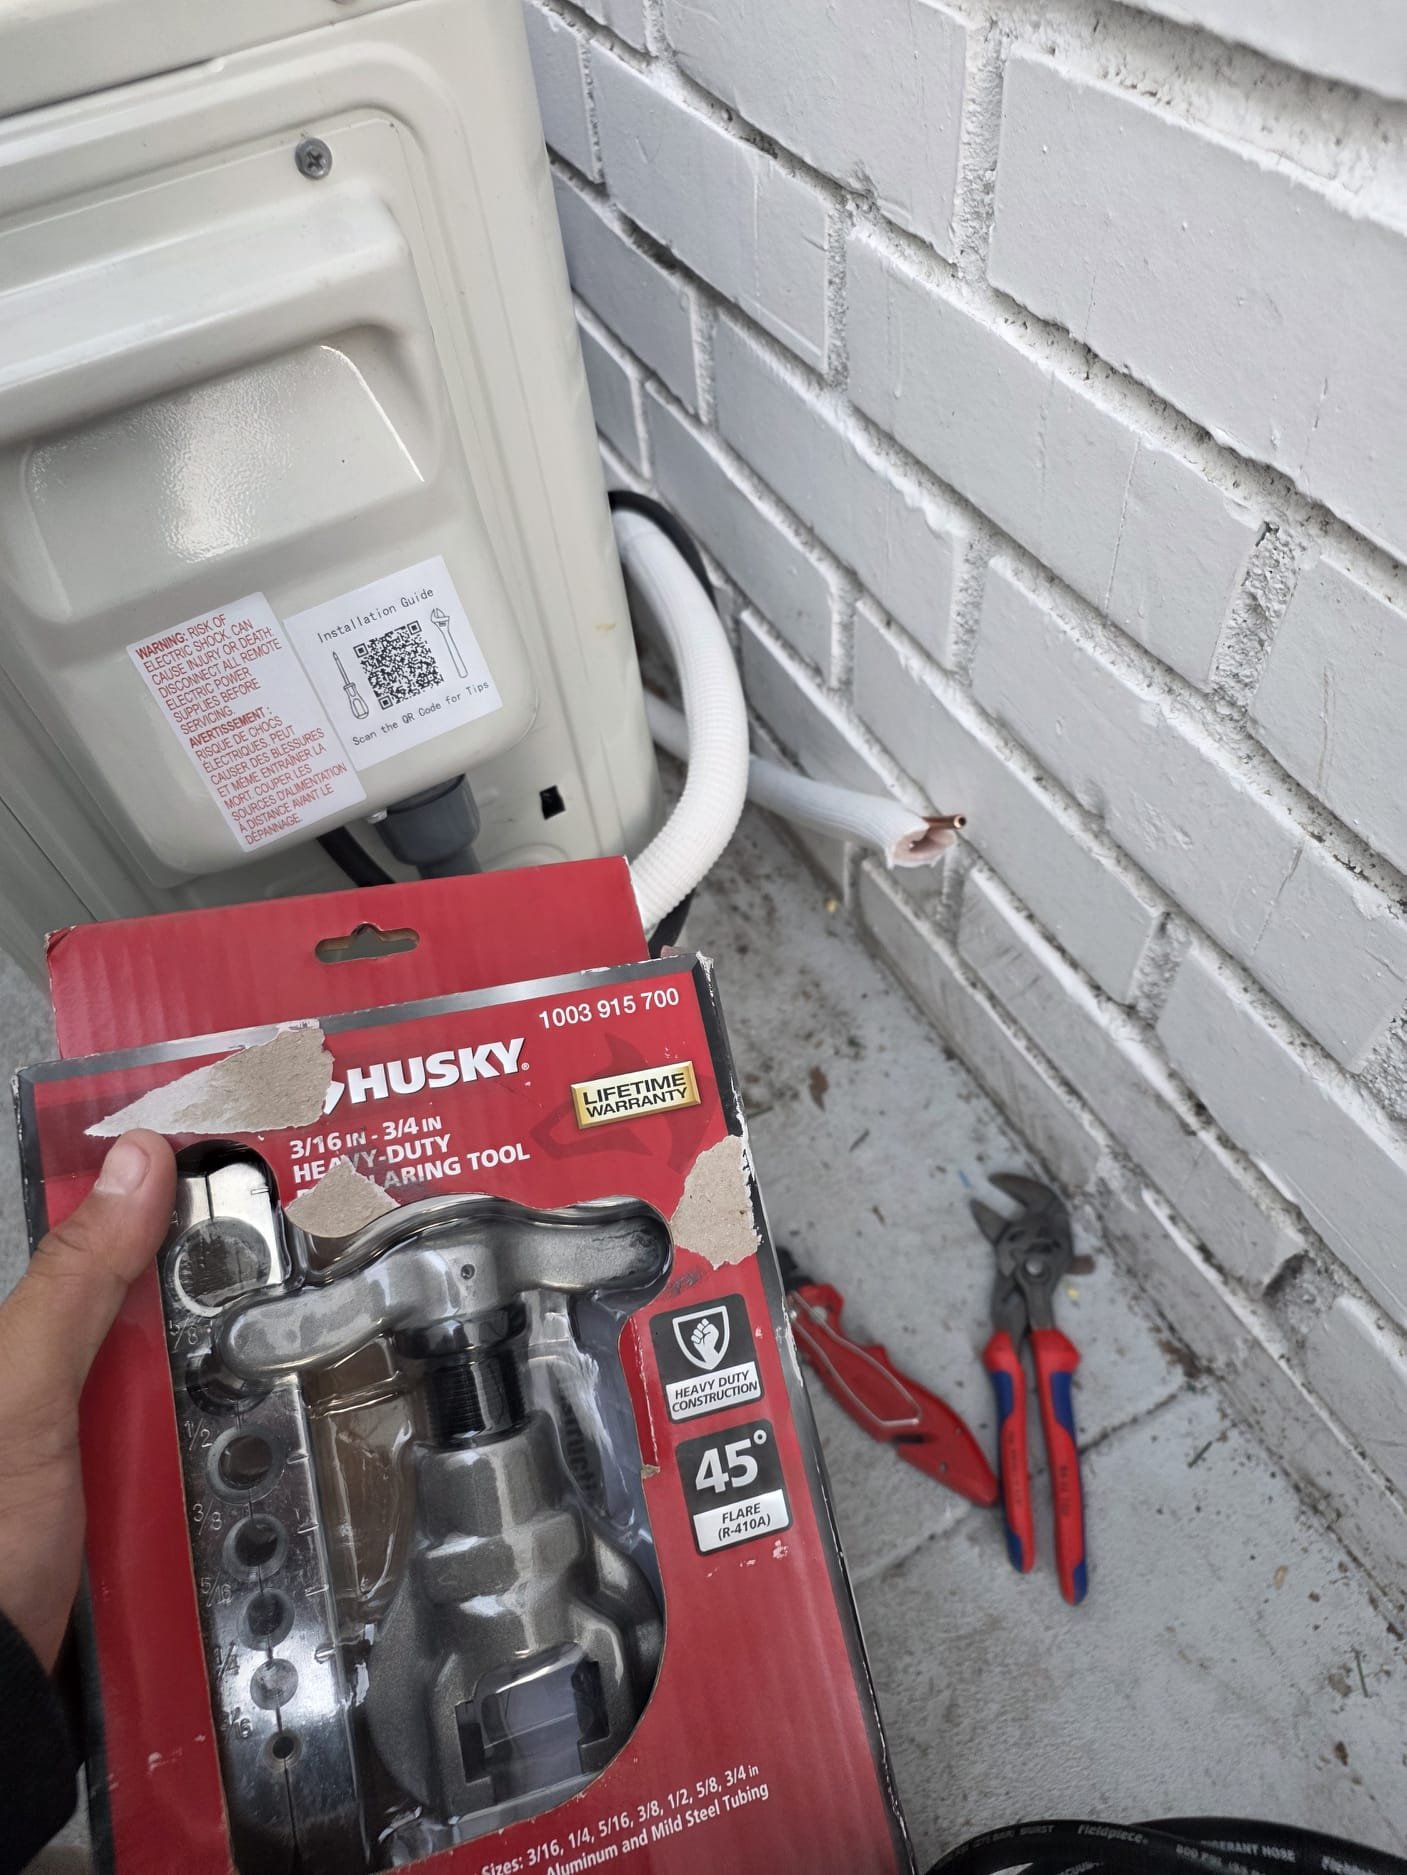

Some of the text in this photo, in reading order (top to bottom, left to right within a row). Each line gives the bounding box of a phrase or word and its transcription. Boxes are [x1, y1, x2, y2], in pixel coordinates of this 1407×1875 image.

[136, 614, 226, 659] WARNING: RISK OF
[318, 589, 433, 642] Installation Guide
[144, 645, 192, 672] ELECTRIC
[231, 619, 253, 636] CAN
[152, 663, 186, 685] CAUSE
[186, 648, 220, 670] INJURY
[222, 641, 239, 655] OR
[158, 639, 281, 698] DISCONNECT ALL REMOTE
[166, 667, 251, 710] ELECTRIC POWER
[173, 678, 260, 722] SUPPLIES BEFORE
[352, 682, 488, 746] Scan the QR Code for Tips
[190, 708, 264, 747] AVERTISSEMENT
[195, 716, 282, 760] RISQUE DE CHOCS
[269, 725, 294, 744] PEUT
[210, 728, 324, 784] CAUSER DES BLESSURES
[216, 784, 230, 798] ET
[260, 749, 312, 778] ENTRAÎNER
[312, 743, 326, 755] LA
[232, 764, 346, 821] SOURCES D'ALIMENTATION
[254, 772, 293, 796] COUPER
[293, 764, 312, 779] LES
[246, 803, 291, 829] DISTANCE
[292, 789, 319, 809] AVANT
[320, 783, 334, 796] LE
[539, 988, 680, 1030] 1003 915 700
[582, 1072, 686, 1106] LIFETIME
[586, 1086, 688, 1118] WARRANTY
[290, 1132, 342, 1160] 3/16
[346, 1131, 367, 1148] IN
[382, 1117, 420, 1140] 3/4
[422, 1116, 442, 1132] IN
[466, 1143, 530, 1170] TOOL
[672, 1380, 758, 1412] CONSTRUCTION
[675, 1370, 750, 1400] HEAVY DUTY
[184, 1418, 214, 1451] 1/2
[695, 1429, 767, 1494] 45°
[192, 1500, 222, 1536] 3/8
[718, 1514, 771, 1541] (R-410A)
[722, 1502, 761, 1524] FLARE
[200, 1570, 232, 1608] 5/16
[482, 1764, 759, 1875] Sizes: 3/16, 1/4, 5/16, 3/8, 1/2, 5/8, 3/4 in
[547, 1783, 769, 1875] Aluminum and Mild Steel Tubing
